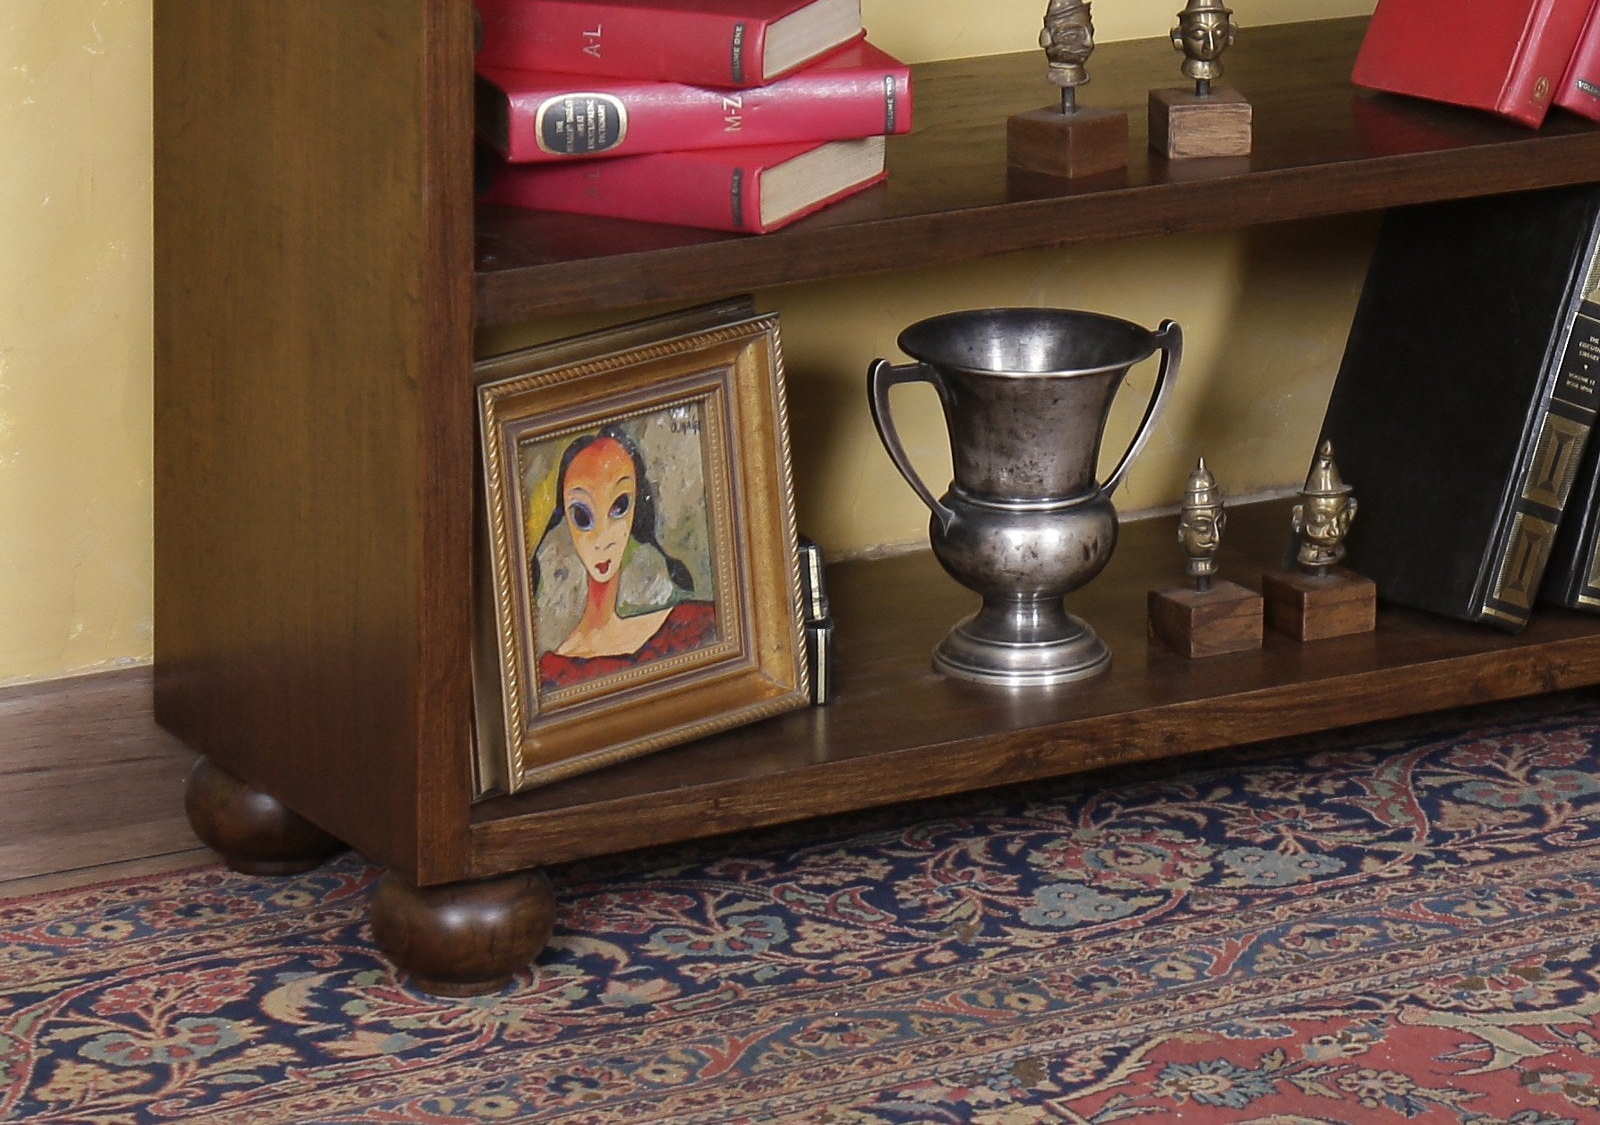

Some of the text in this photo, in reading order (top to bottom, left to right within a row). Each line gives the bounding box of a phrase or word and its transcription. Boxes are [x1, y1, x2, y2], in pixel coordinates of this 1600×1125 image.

[582, 23, 602, 58] A-L
[734, 25, 743, 44] ONE
[722, 95, 743, 133] M-Z
